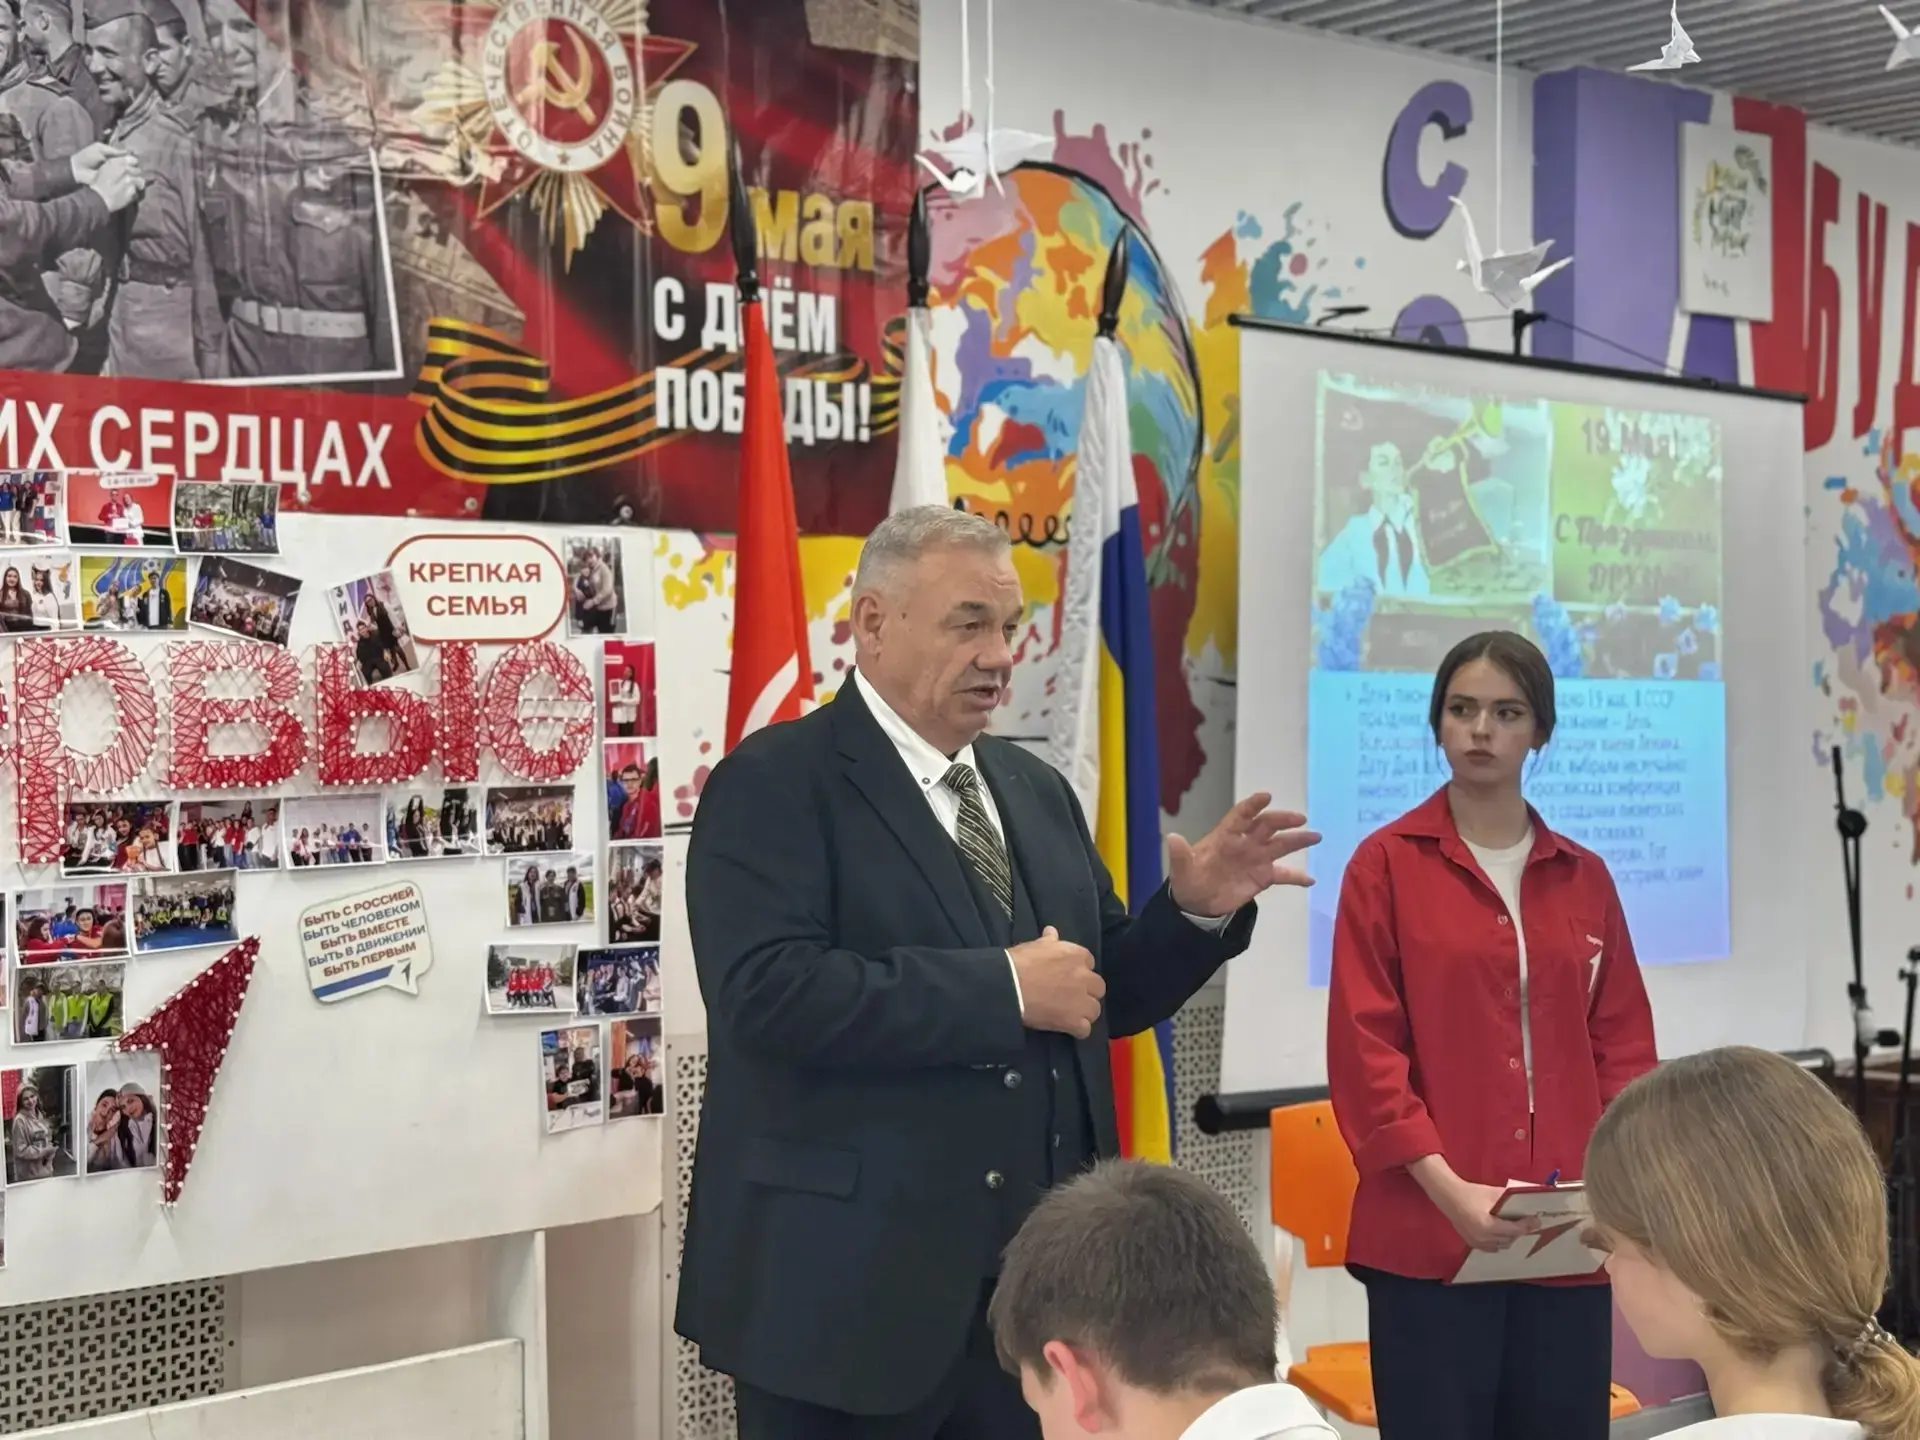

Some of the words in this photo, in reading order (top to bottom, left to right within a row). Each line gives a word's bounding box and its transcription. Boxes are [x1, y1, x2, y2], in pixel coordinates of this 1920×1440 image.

[652, 79, 729, 253] 9
[747, 186, 874, 270] мая
[653, 276, 686, 341] С
[701, 275, 836, 354] ДЁМ
[654, 366, 871, 446] ПОБДЫ!
[89, 404, 393, 494] СЕРДЦАХ
[409, 562, 542, 583] КРЕПКАЯ
[426, 595, 528, 616] СЕМЬЯ
[303, 925, 341, 941] БЫТЬ
[341, 899, 421, 929] ЧЕЛОВЕКОМ
[304, 910, 341, 928] БЫТЬ
[342, 905, 352, 916] С
[354, 886, 415, 914] РОССИЕЙ
[308, 950, 344, 968] БЫТЬ
[345, 946, 354, 956] В
[356, 925, 426, 955] ДВИЖЕНИИ
[320, 933, 357, 951] БЫТЬ
[358, 916, 410, 940] ВМЕСТЕ
[323, 959, 360, 978] БЫТЬ
[361, 941, 417, 966] ПЕРВЫМ
